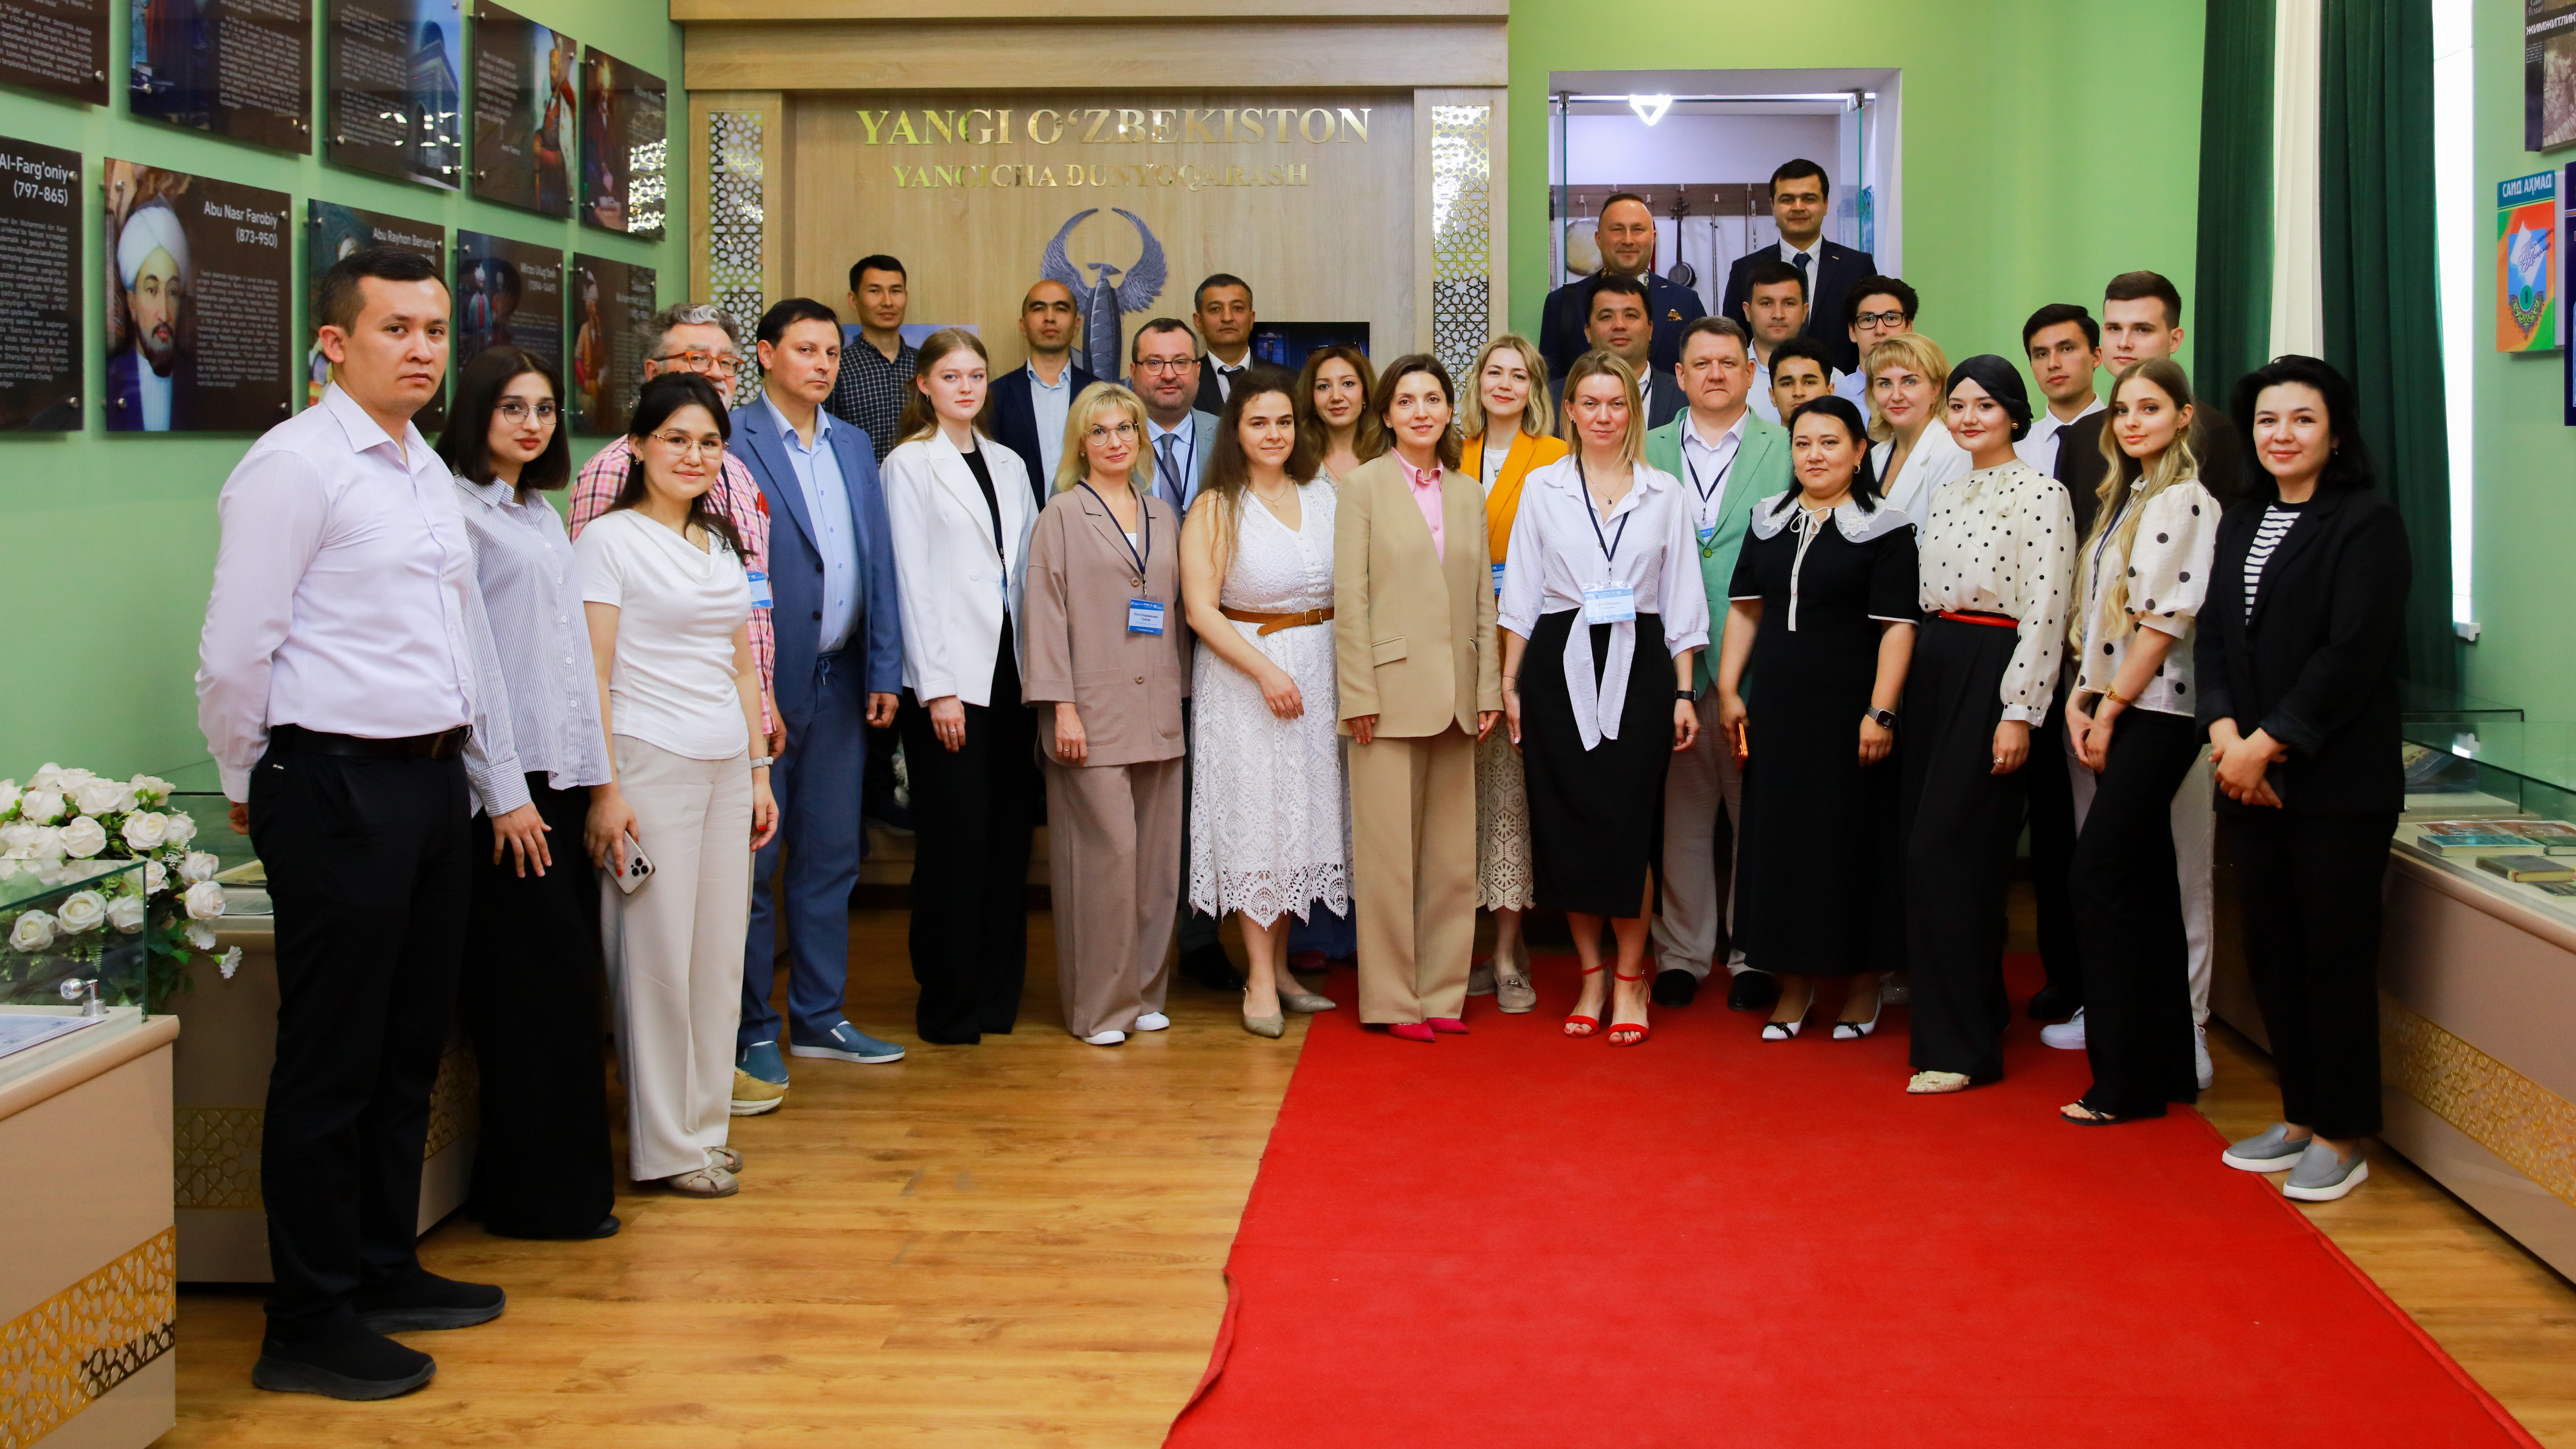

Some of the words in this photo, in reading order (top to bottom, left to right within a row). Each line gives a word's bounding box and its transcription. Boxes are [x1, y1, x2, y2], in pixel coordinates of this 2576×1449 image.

[2526, 12, 2576, 36] ЖИМЖИТЛИК
[855, 108, 1014, 145] YANGI
[892, 164, 1058, 188] YANGICHA
[1065, 164, 1308, 192] DUNYOQARASH
[2502, 180, 2522, 197] САИД
[13, 179, 68, 207] (797-865)
[204, 201, 222, 217] Abu
[224, 204, 245, 221] Nasr
[246, 208, 278, 230] Farobiy
[237, 227, 278, 249] (873-950)
[373, 227, 387, 241] Abu
[2525, 290, 2528, 303] 1
